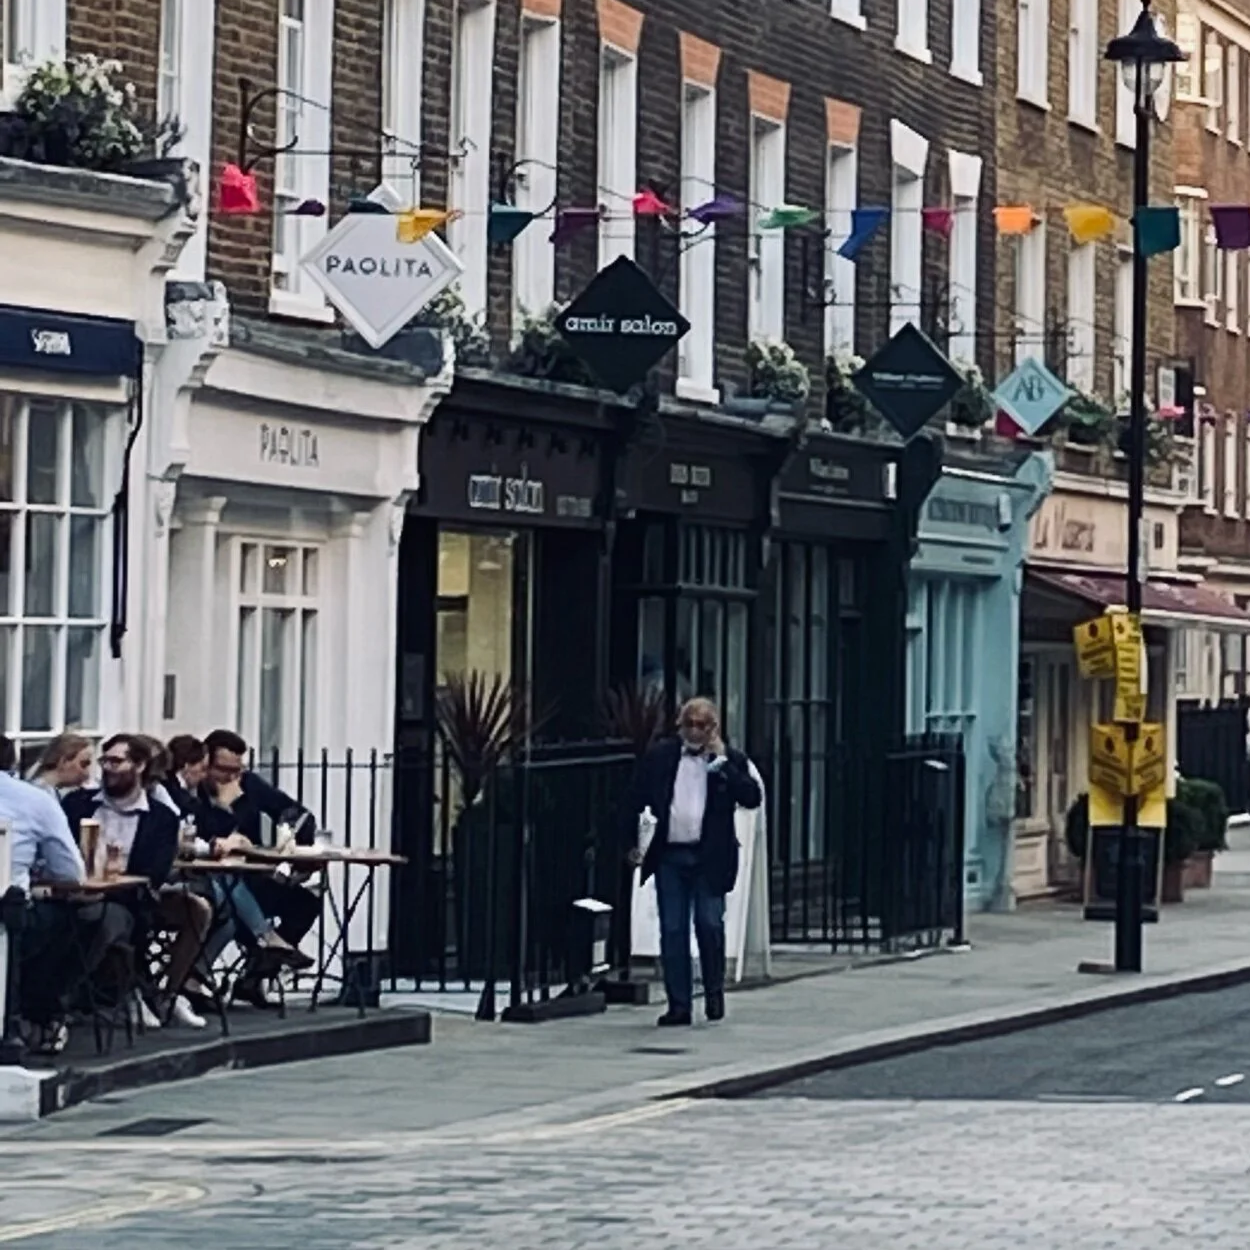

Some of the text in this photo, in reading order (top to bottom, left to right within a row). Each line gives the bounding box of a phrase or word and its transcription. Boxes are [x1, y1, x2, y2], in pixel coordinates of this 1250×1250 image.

[326, 255, 433, 278] PAOLITA
[565, 313, 678, 335] amir salon
